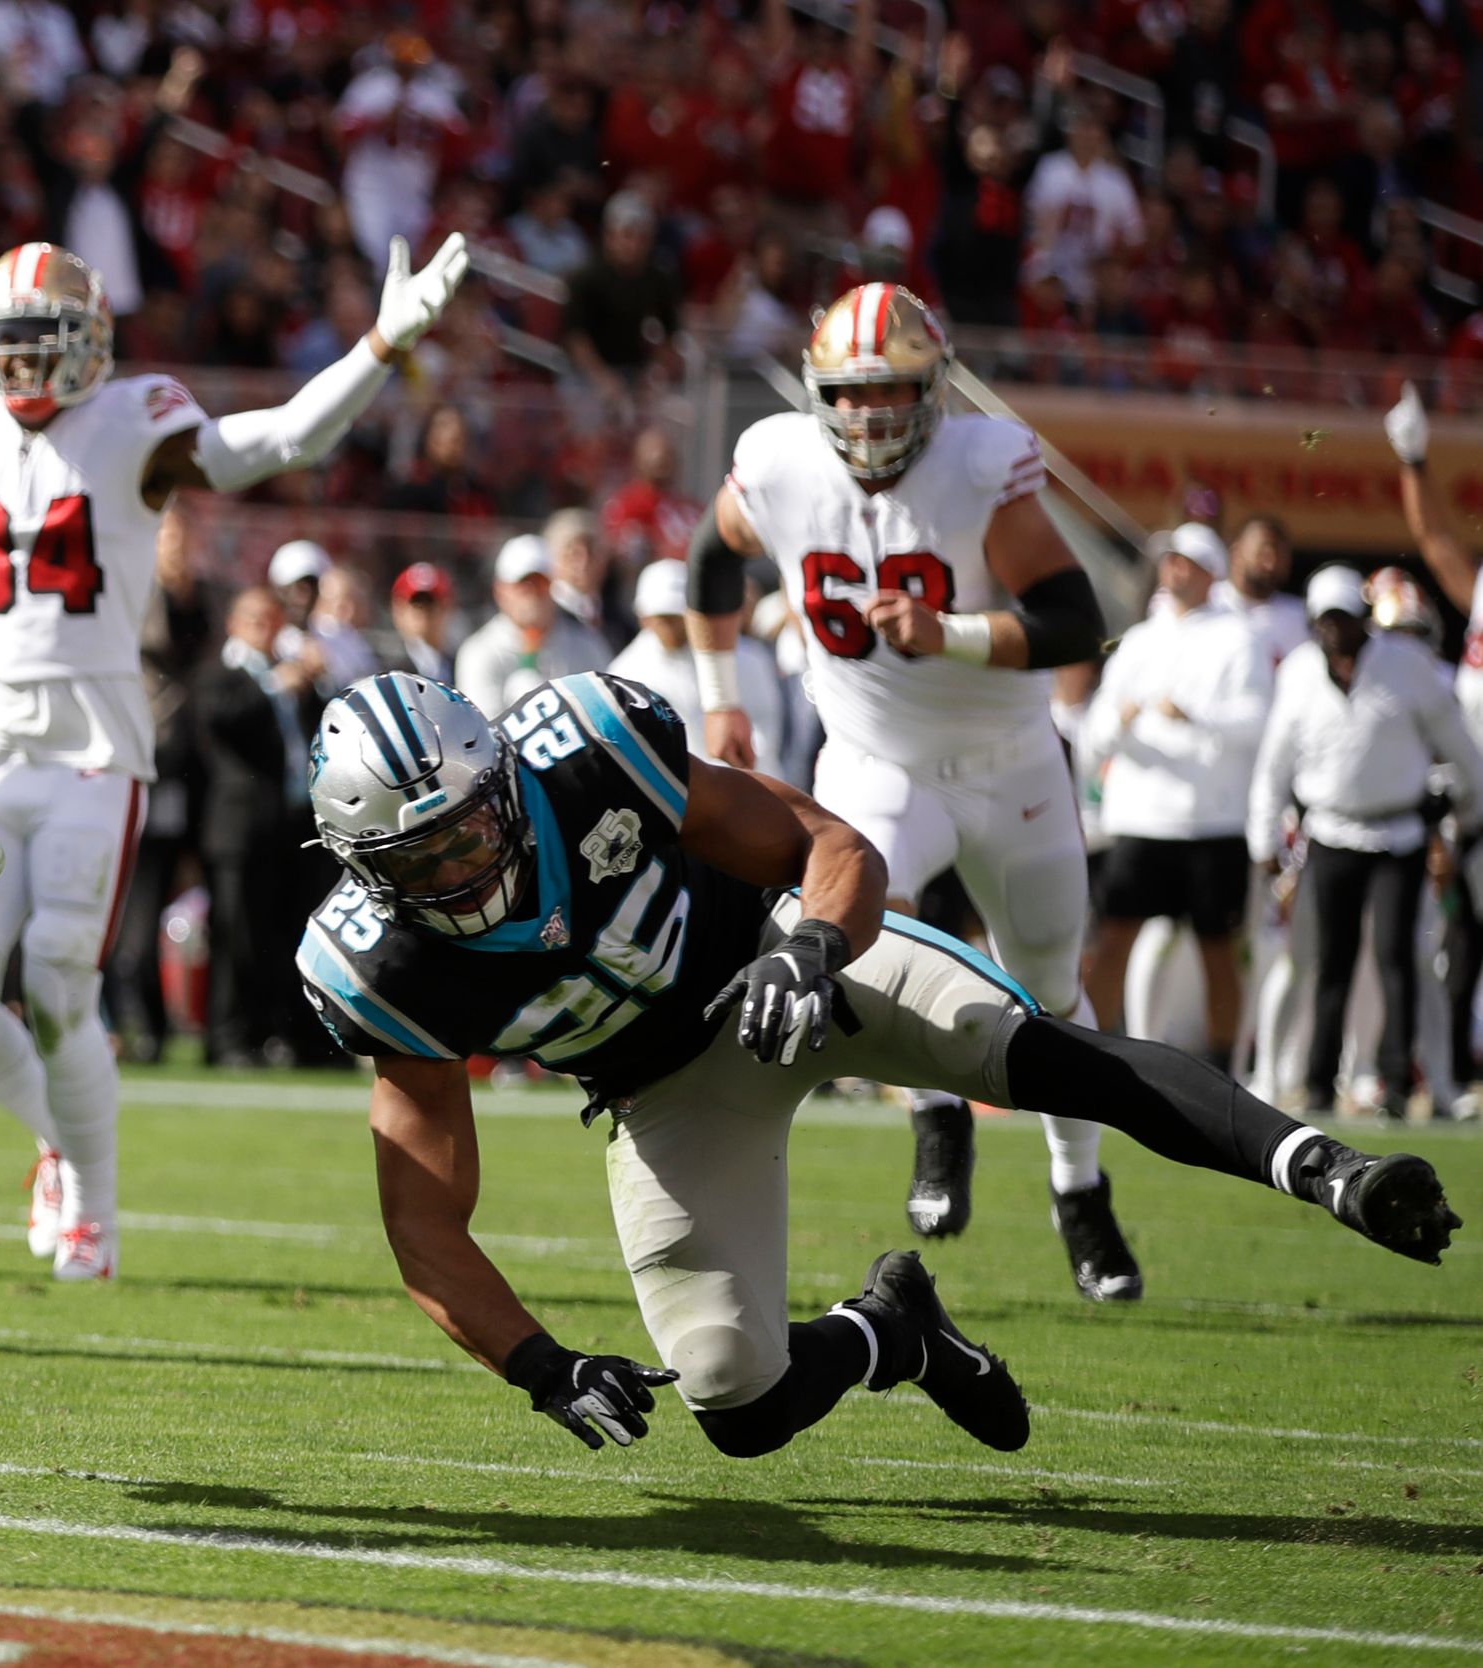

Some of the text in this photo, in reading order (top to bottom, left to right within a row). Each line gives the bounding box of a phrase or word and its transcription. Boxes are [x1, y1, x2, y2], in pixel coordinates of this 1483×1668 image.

[502, 688, 585, 770] 25
[315, 879, 385, 953] 25
[491, 857, 690, 1064] 25
